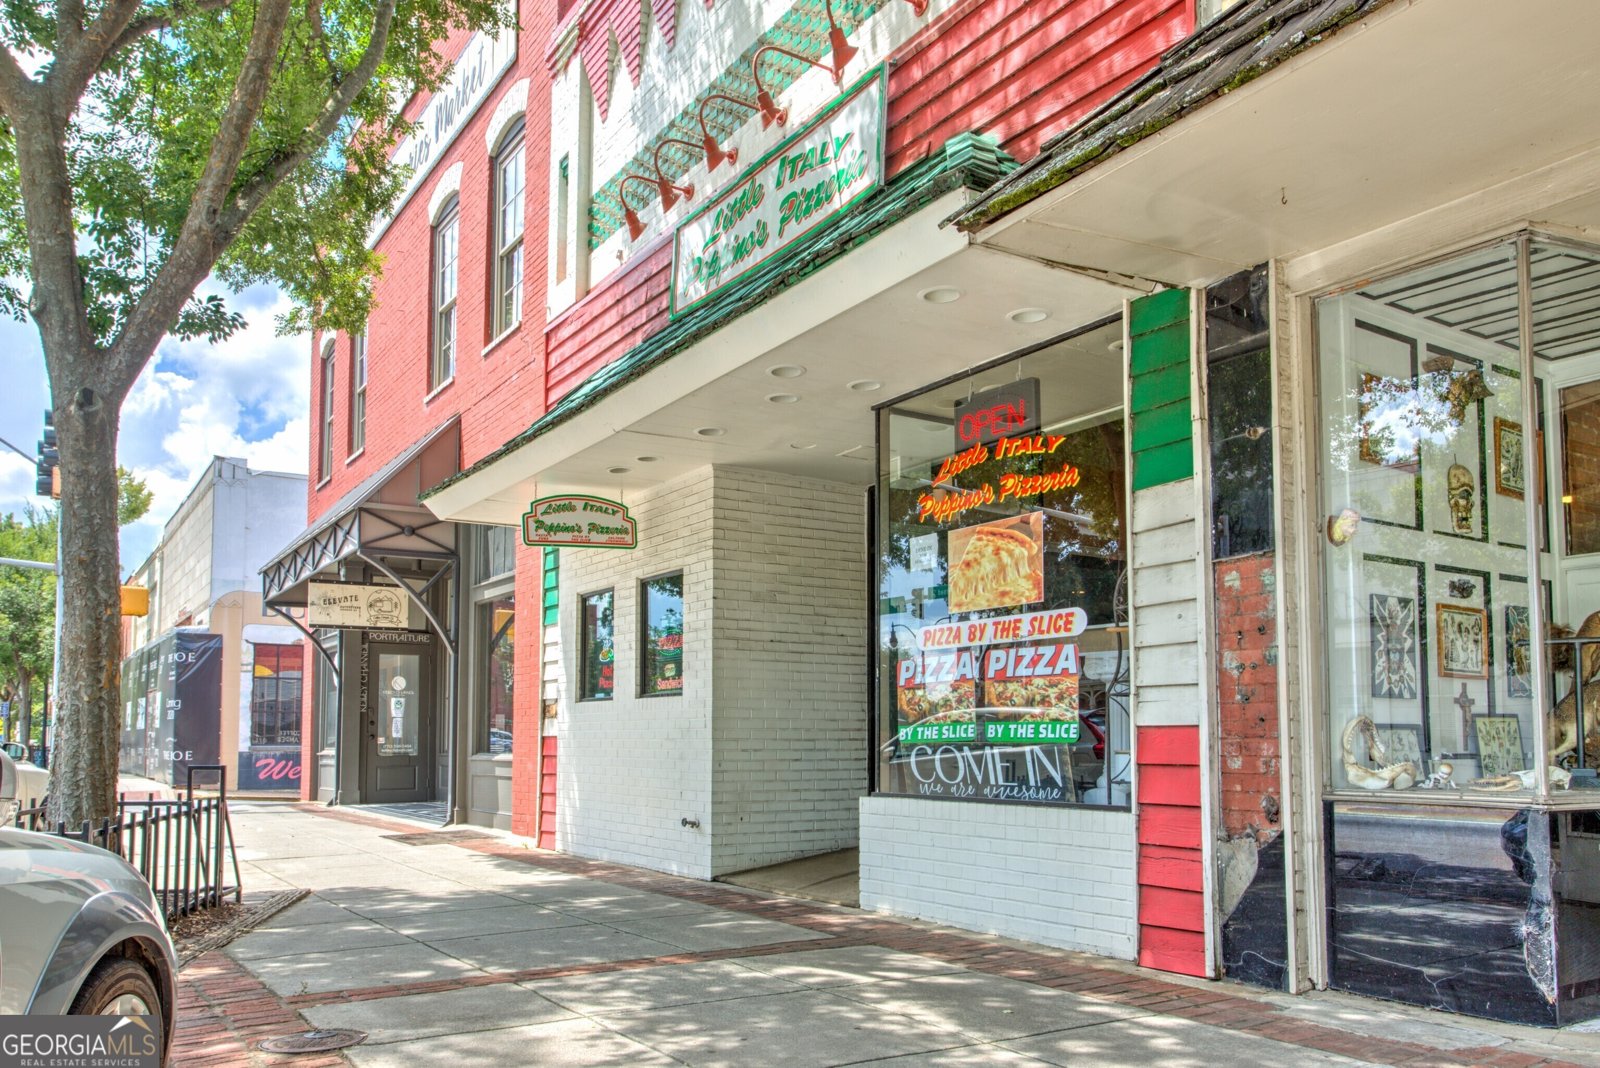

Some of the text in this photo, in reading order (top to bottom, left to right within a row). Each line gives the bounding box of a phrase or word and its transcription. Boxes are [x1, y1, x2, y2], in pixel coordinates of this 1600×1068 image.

[434, 41, 487, 144] Market
[702, 131, 855, 255] Little ITALY
[777, 149, 868, 239] Pizzeria
[959, 398, 1027, 442] OPEN
[932, 434, 1066, 487] Little ITALY
[540, 501, 621, 516] Little ITALY
[918, 463, 1081, 524] Peppino's Pizzeria
[534, 519, 630, 537] Peppino's Pizzeria
[322, 594, 359, 606] ELEVATE
[369, 632, 430, 642] PORTRAITURE
[923, 611, 1076, 648] PIZZA BY THE SLICE
[899, 652, 975, 686] PIZZA
[987, 642, 1078, 680] PIZZA
[900, 723, 975, 741] BY THE SLICE
[987, 723, 1078, 738] BY THE SLICE
[256, 758, 301, 780] We
[910, 745, 1063, 788] COME IN
[919, 783, 1062, 800] we are awesome
